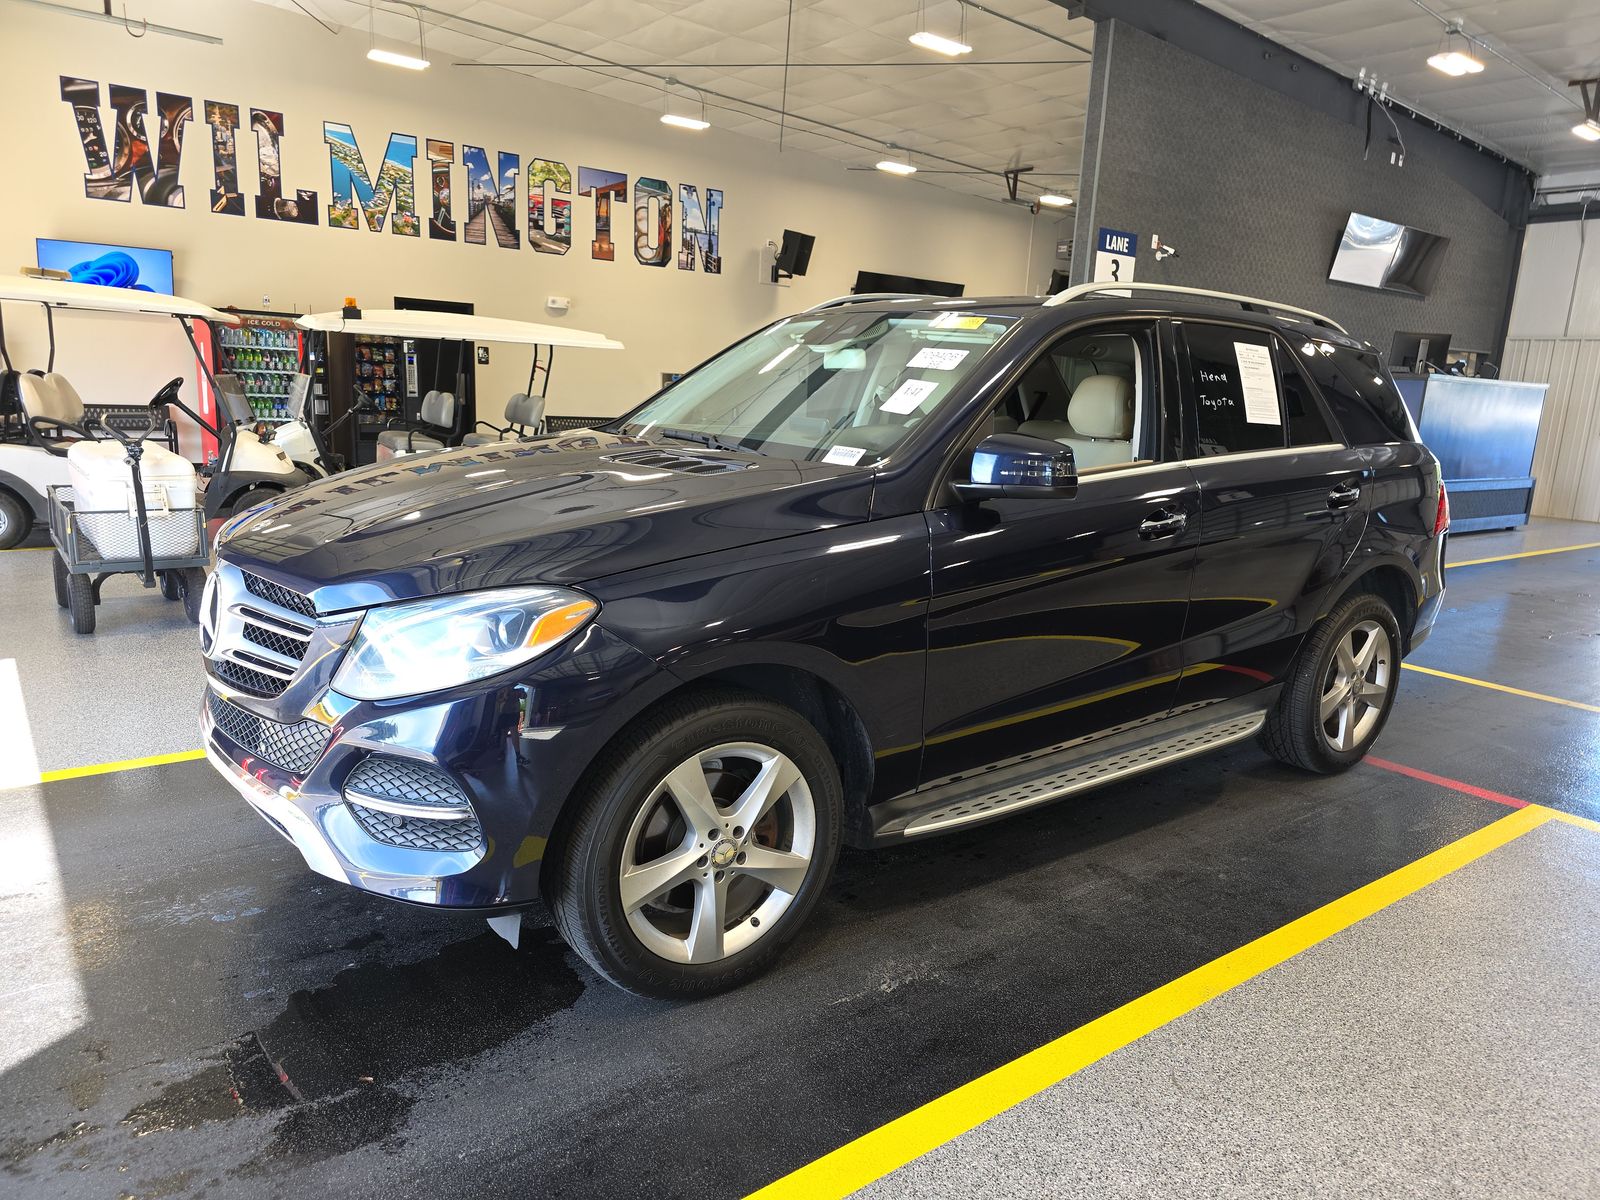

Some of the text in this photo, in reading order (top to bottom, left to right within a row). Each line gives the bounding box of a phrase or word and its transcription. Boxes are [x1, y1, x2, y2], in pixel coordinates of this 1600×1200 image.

[60, 75, 723, 275] WILMINGTON
[1105, 234, 1130, 253] LANE
[1199, 394, 1235, 411] Toyota
